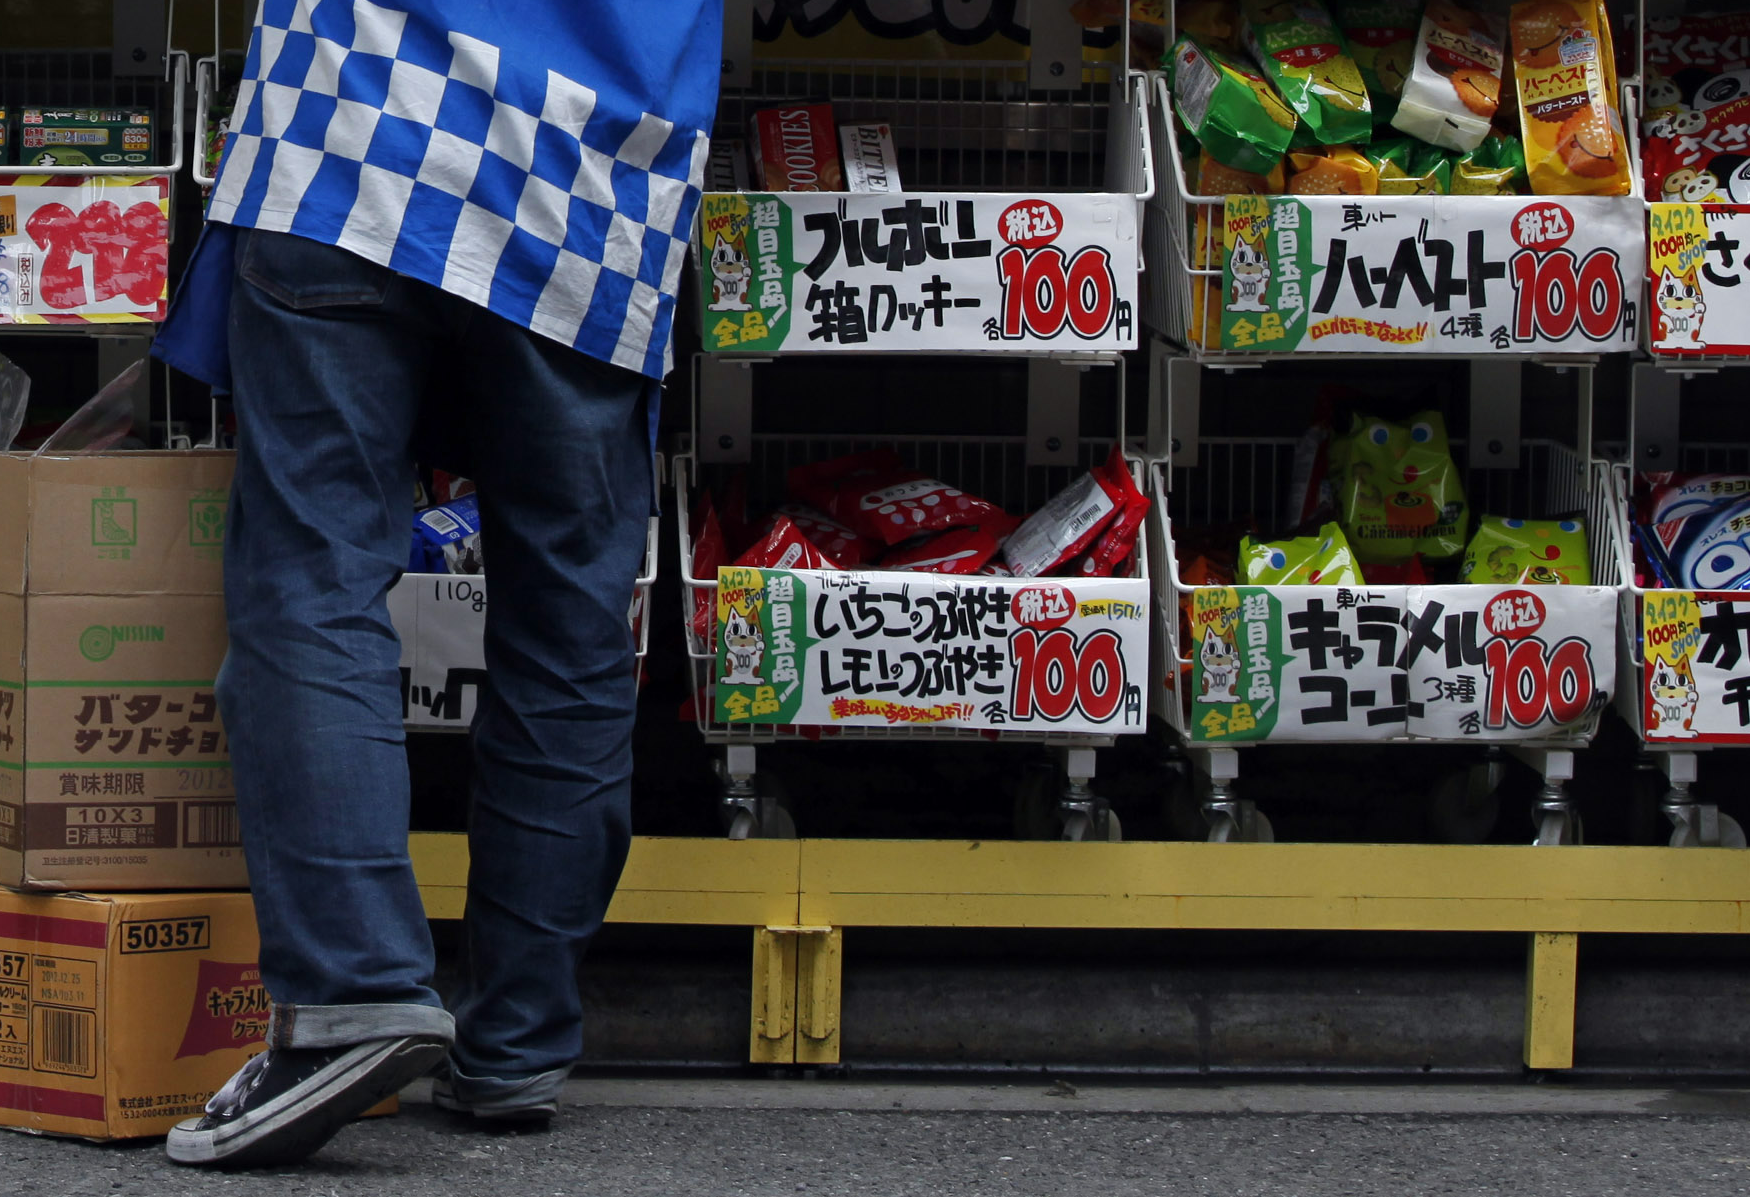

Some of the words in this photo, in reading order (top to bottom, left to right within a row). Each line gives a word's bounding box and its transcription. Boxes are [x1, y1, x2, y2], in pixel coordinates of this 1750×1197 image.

[804, 198, 992, 282] ブルボン
[1004, 209, 1057, 241] 税込
[1343, 204, 1397, 232] 東ハト
[1518, 212, 1570, 242] 税込
[1312, 219, 1506, 314] ハーベスト
[805, 274, 981, 345] 箱クッキー
[997, 244, 1117, 341] 100
[1509, 246, 1625, 344] 100
[1116, 299, 1132, 341] 円
[815, 583, 1010, 642] いちごのつぶやき
[1018, 590, 1071, 624] 税込
[1338, 588, 1385, 610] 東ハト
[113, 625, 165, 643] NISSIN
[1287, 598, 1486, 671] キャラメル
[821, 645, 1005, 698] レモンのつぶやき
[1008, 626, 1127, 723] 100
[1484, 635, 1595, 730] 100
[1300, 676, 1424, 726] コーン
[59, 773, 146, 796] 賞味期限
[65, 827, 138, 845] 日清製菓
[77, 807, 144, 823] 10X3
[126, 922, 205, 950] 50357
